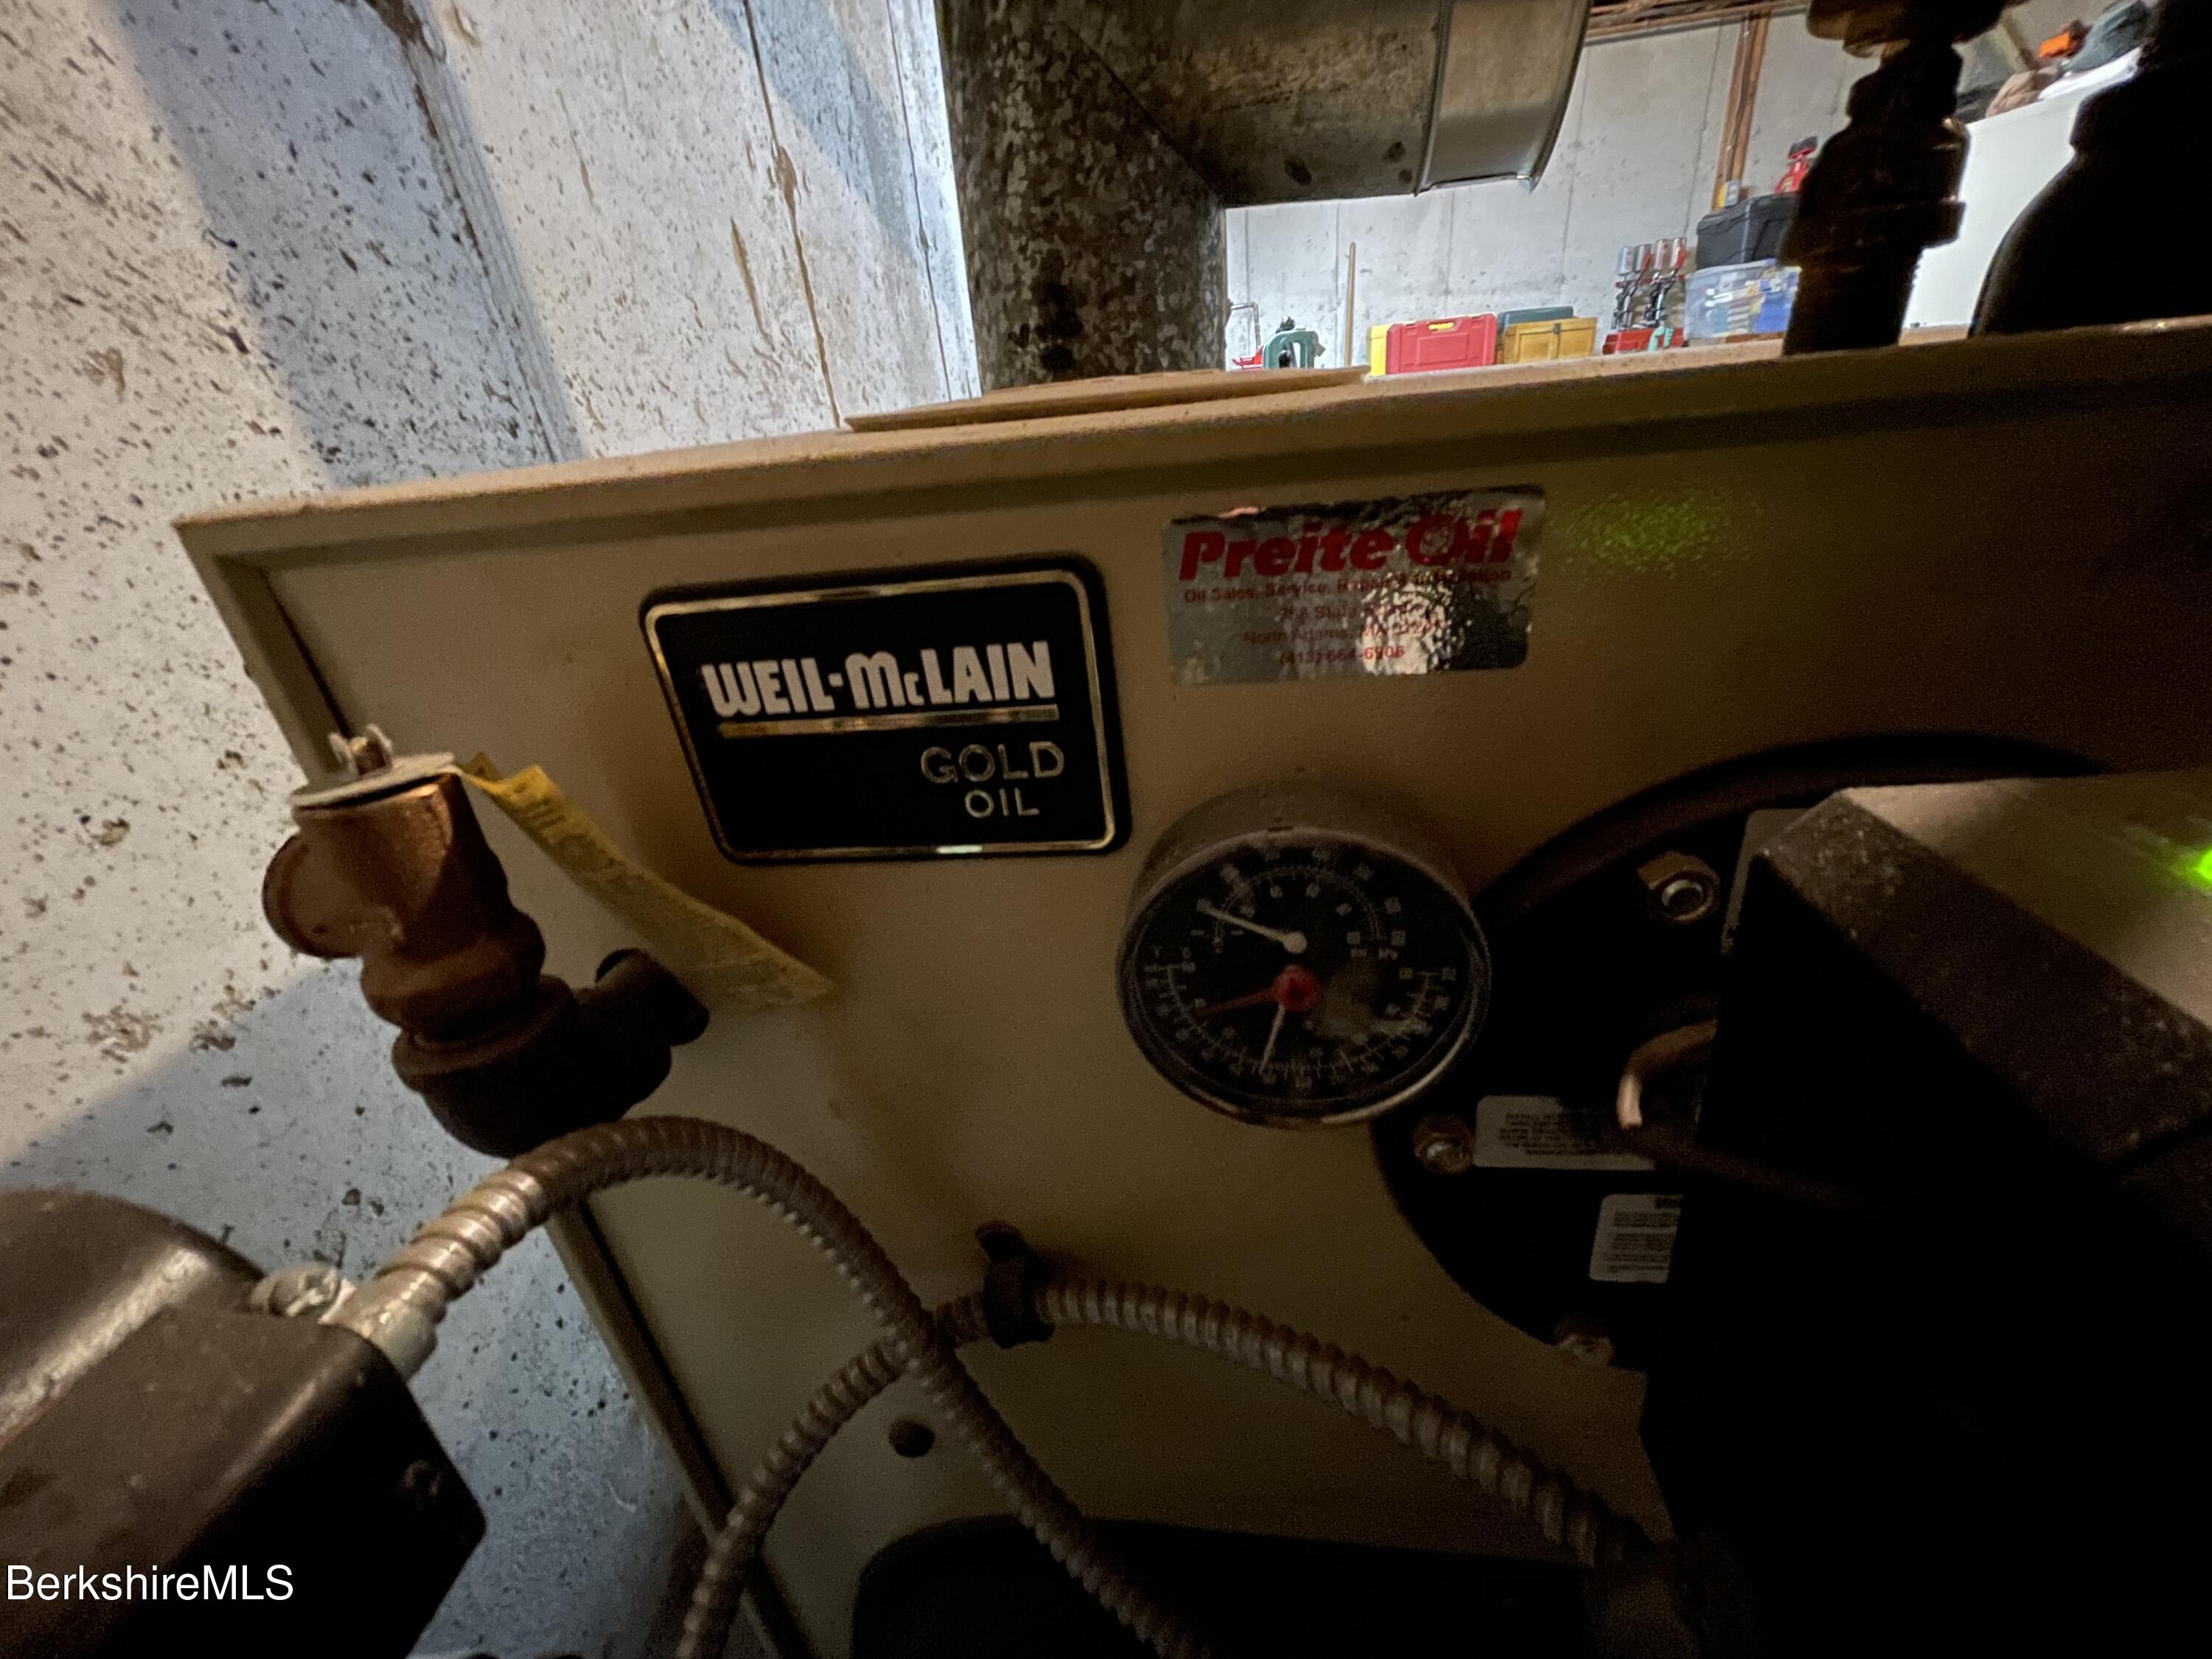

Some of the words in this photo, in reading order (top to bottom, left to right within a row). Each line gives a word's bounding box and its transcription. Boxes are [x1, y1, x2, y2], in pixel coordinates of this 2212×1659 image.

[1178, 521, 1394, 581] Preite
[1405, 508, 1523, 568] Oil
[919, 740, 1065, 784] GOLD
[963, 788, 1040, 818] OIL
